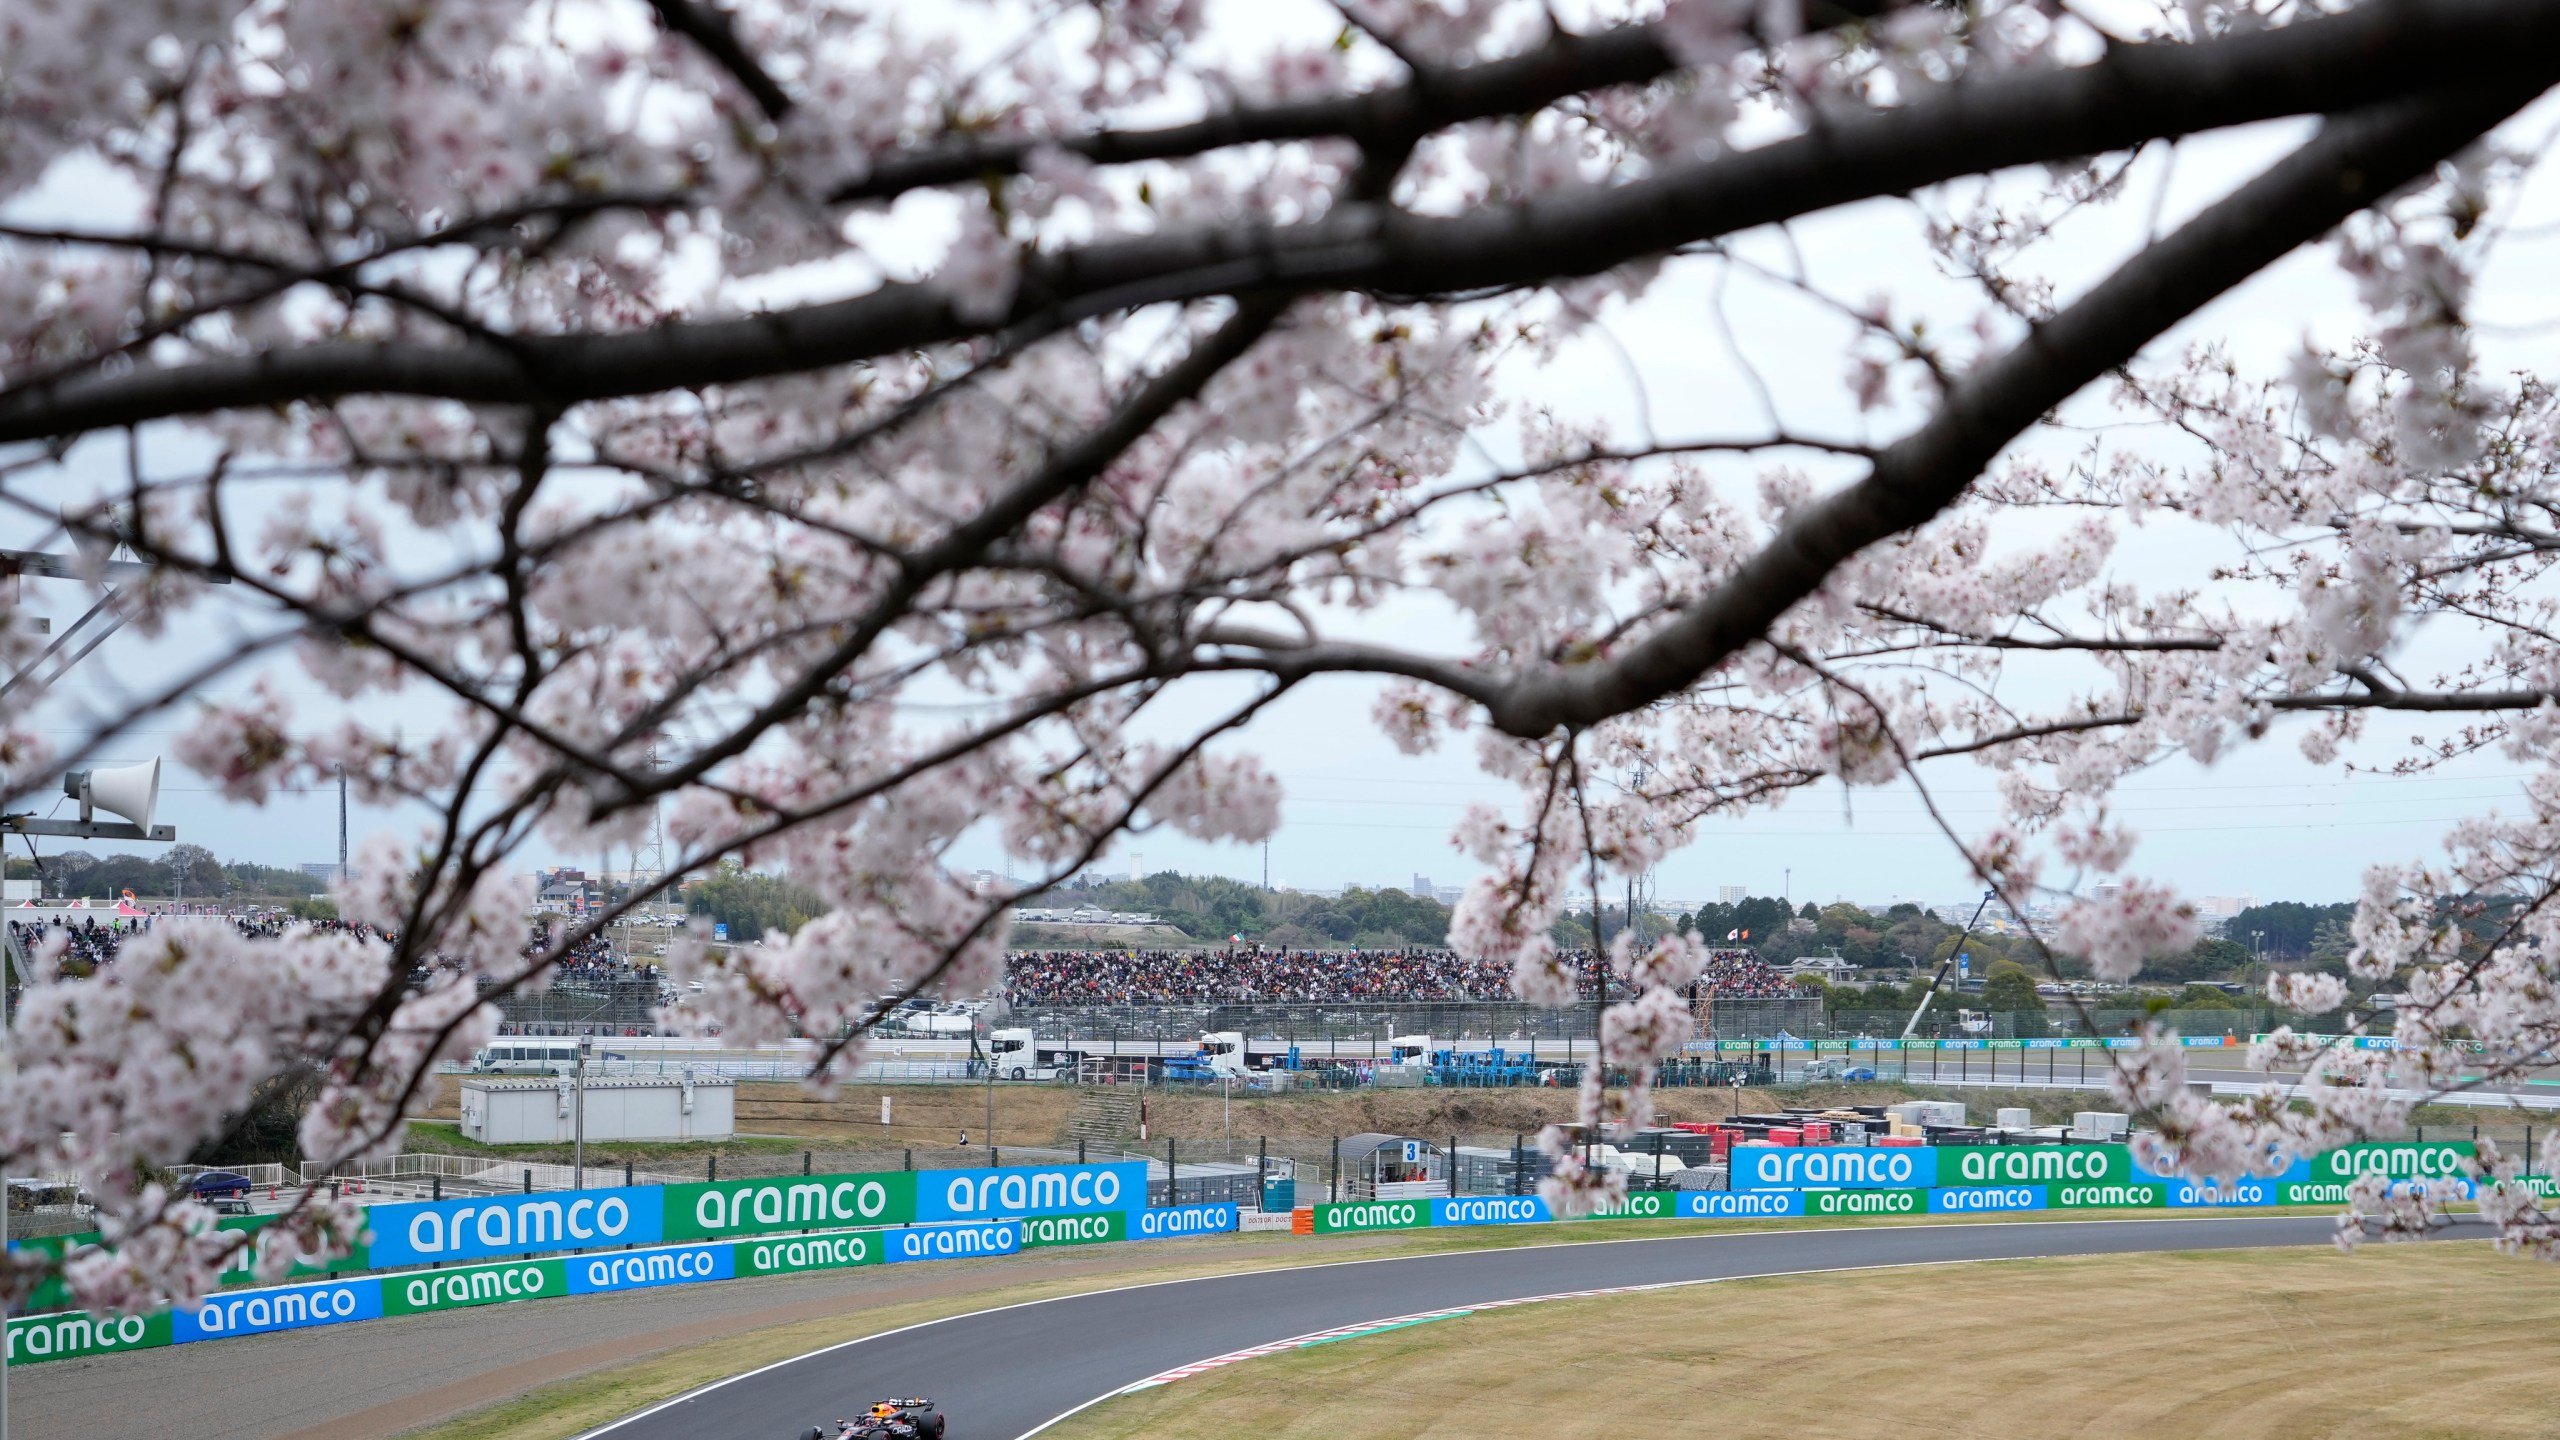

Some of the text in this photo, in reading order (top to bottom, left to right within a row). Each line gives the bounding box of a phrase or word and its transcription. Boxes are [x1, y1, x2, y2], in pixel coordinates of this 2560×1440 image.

[2029, 1039, 2062, 1048] aramco
[2111, 1039, 2137, 1047] aram
[2189, 1038, 2220, 1046] aramco
[1406, 1143, 1416, 1161] 3
[1961, 1151, 2108, 1180] aramco
[2331, 1147, 2458, 1176] aramco
[1757, 1153, 1911, 1182] aramco
[947, 1170, 1120, 1212] aramco
[1692, 1195, 1789, 1214] aramco
[1820, 1193, 1913, 1212] aramco
[1942, 1190, 2032, 1209] aramco
[2060, 1186, 2153, 1205] aramco
[2289, 1184, 2352, 1202] aramc
[696, 1181, 886, 1229] aramco
[1327, 1205, 1416, 1228] aramco
[1445, 1199, 1536, 1221] aramco
[1566, 1196, 1660, 1216] amco
[409, 1196, 629, 1253] aramco
[1022, 1216, 1109, 1243] aramco
[1141, 1207, 1227, 1234] aramco
[753, 1237, 866, 1270] aramco
[903, 1227, 1013, 1256] aramco
[588, 1251, 714, 1286] aramco
[407, 1267, 544, 1306] aramco
[198, 1288, 356, 1332] aramco
[7, 1314, 146, 1359] ramco
